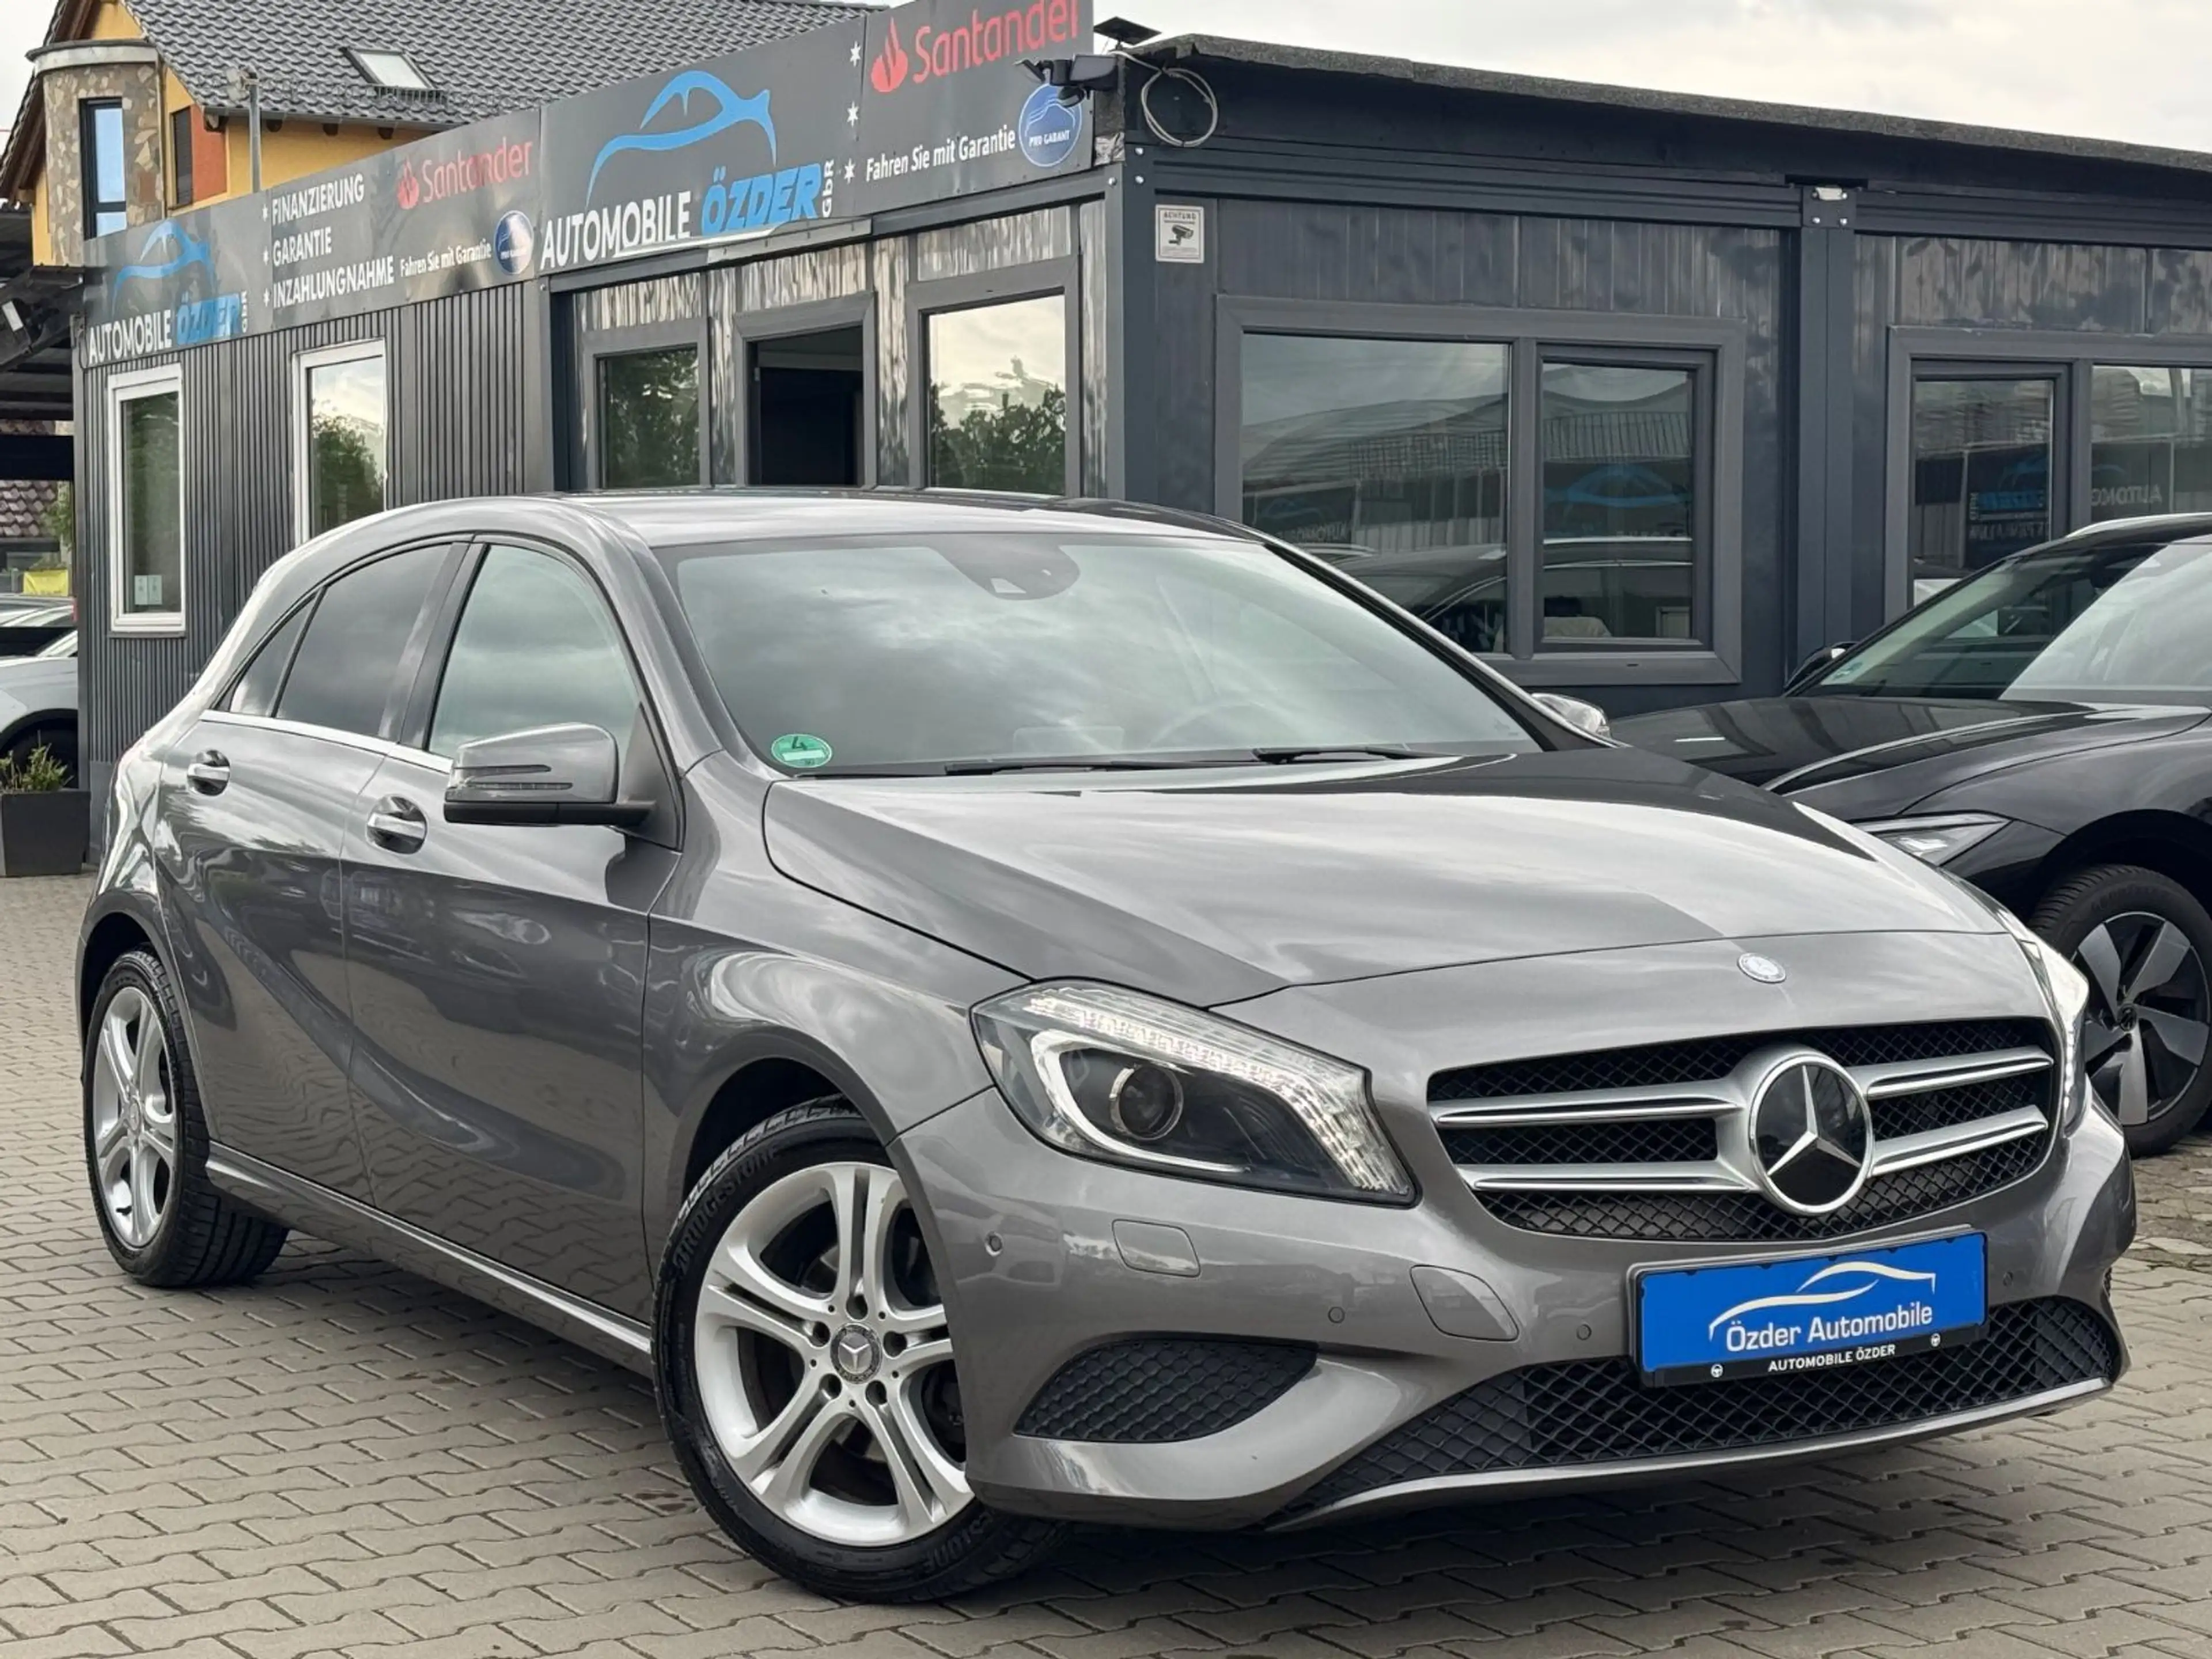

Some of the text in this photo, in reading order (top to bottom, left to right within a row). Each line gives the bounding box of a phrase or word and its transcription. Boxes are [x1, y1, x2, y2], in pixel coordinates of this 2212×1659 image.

[866, 124, 1016, 181] Fahren Sie mit Garantie
[1028, 130, 1070, 147] PRO GARANT
[422, 136, 533, 203] Santander
[822, 159, 834, 218] GbR
[272, 173, 364, 226] FINANZIERUNG
[539, 162, 821, 270] AUTOMOBILE ÖZDER
[273, 226, 331, 267] GARANTIE
[400, 256, 426, 277] Fahren
[427, 251, 440, 271] Sie
[441, 246, 454, 267] mit
[456, 238, 491, 264] Garantie
[272, 255, 394, 308] INZAHLUNGNAHME
[89, 291, 241, 365] AUTOMOBILE ÖZDER
[1726, 1302, 1933, 1352] Özder Automobile
[1768, 1344, 1896, 1373] AUTOMOBILE ÖZDER
